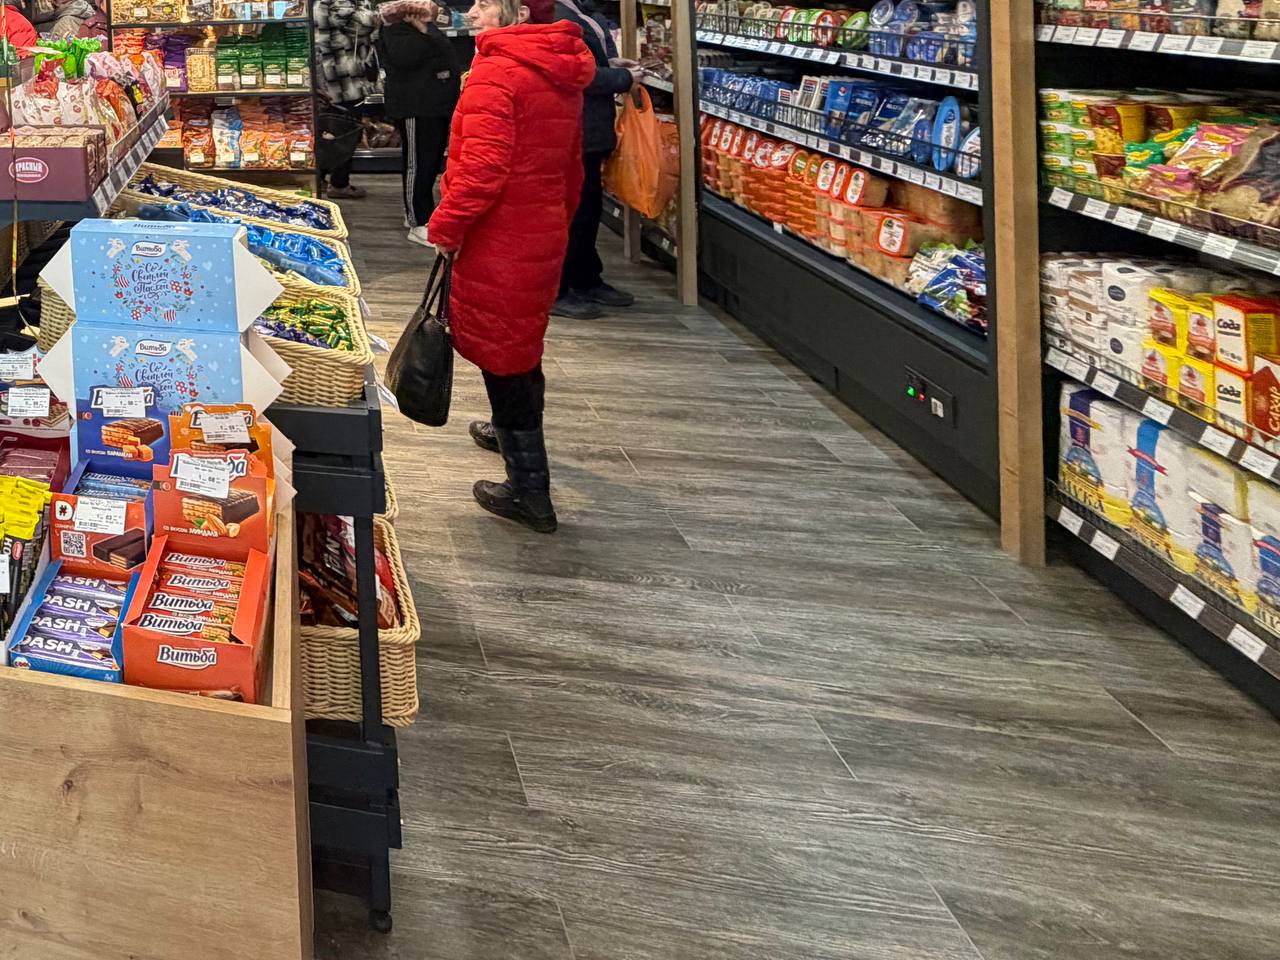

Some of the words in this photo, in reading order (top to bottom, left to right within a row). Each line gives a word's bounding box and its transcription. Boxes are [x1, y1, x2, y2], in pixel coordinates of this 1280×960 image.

[1216, 318, 1241, 331] Сода
[1216, 384, 1242, 398] Сода
[151, 593, 213, 610] Витьба
[139, 614, 203, 632] Витьба
[21, 635, 74, 654] DASH
[159, 646, 216, 664] Витьба
